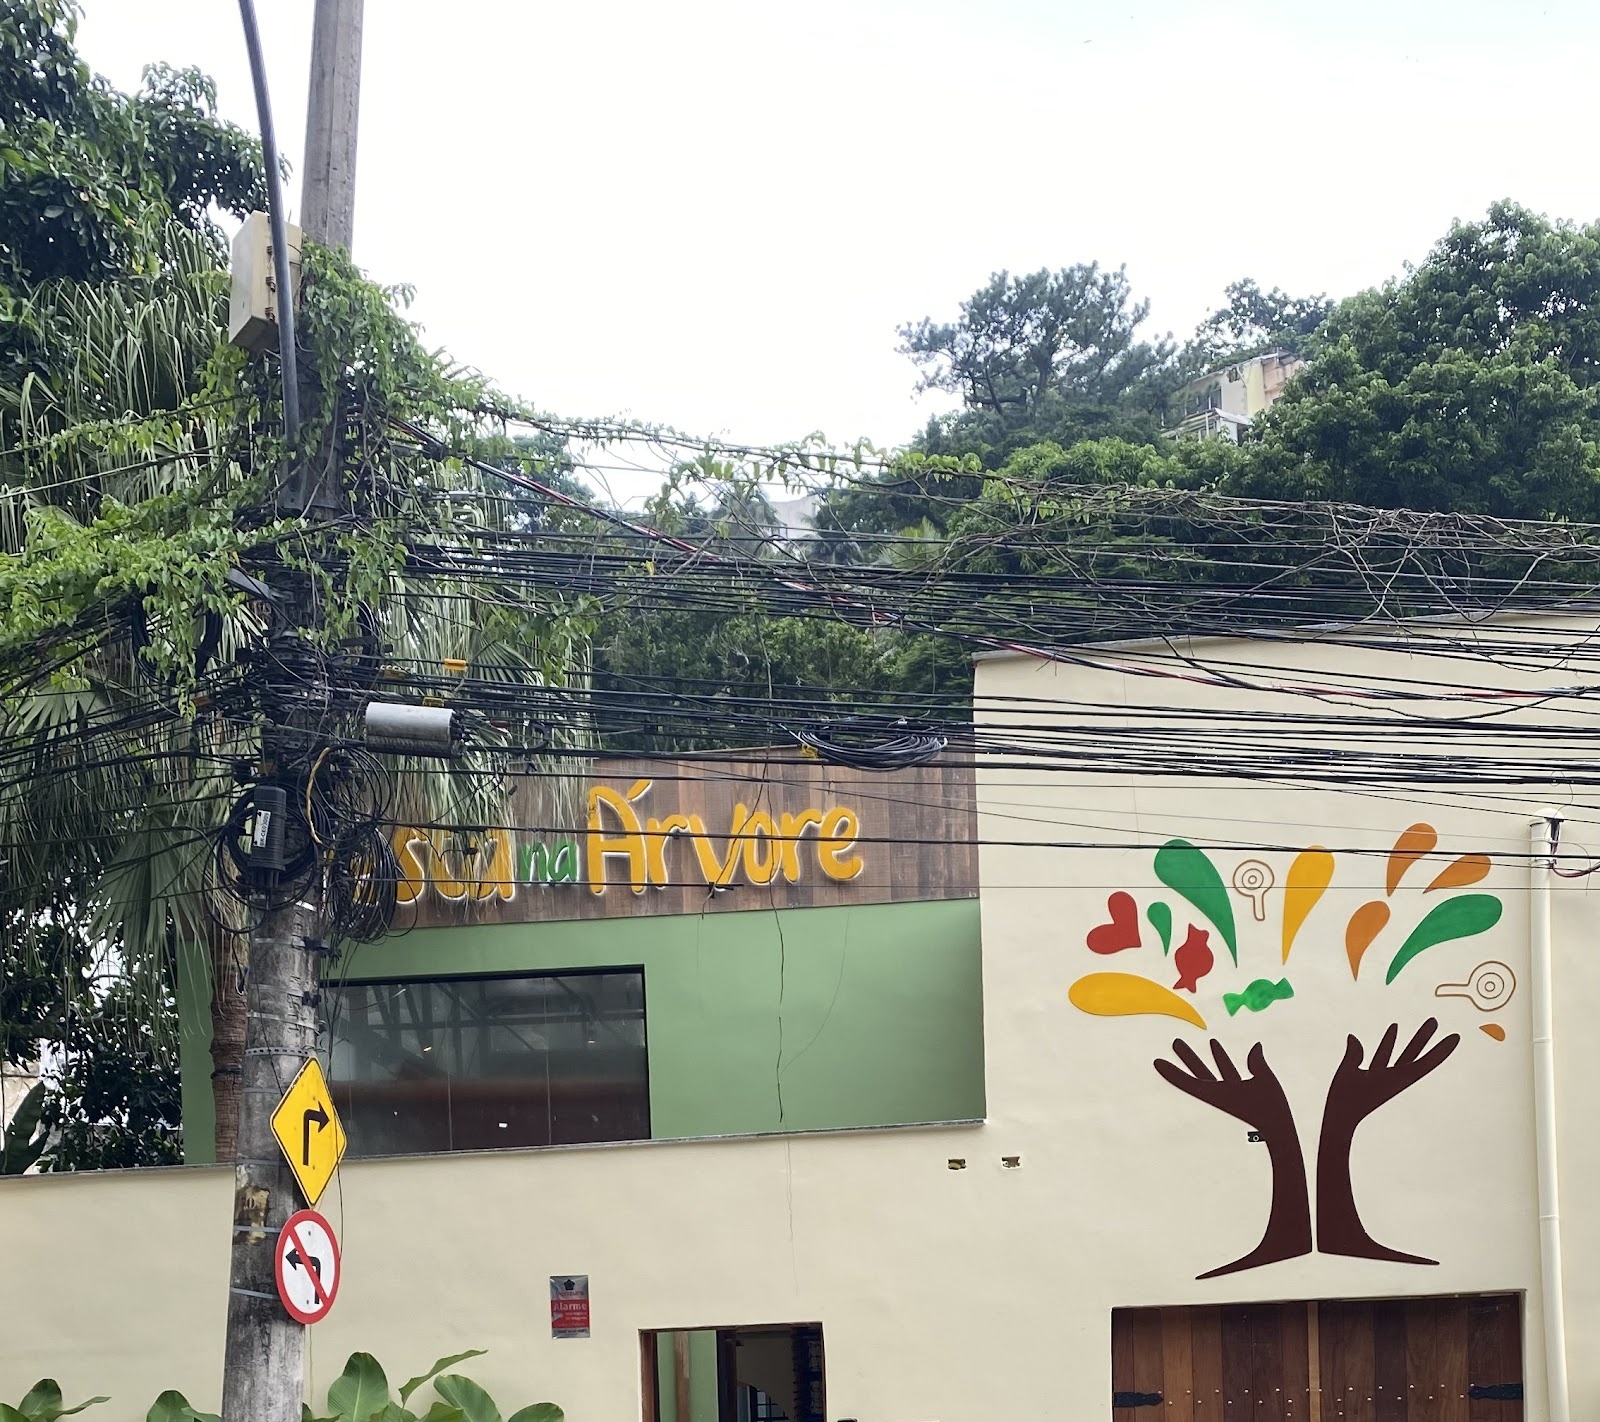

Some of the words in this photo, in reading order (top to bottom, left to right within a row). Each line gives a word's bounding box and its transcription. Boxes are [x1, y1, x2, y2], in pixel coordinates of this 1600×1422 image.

[520, 838, 579, 886] na
[587, 779, 864, 896] Árvore
[553, 1302, 587, 1311] Alarme
